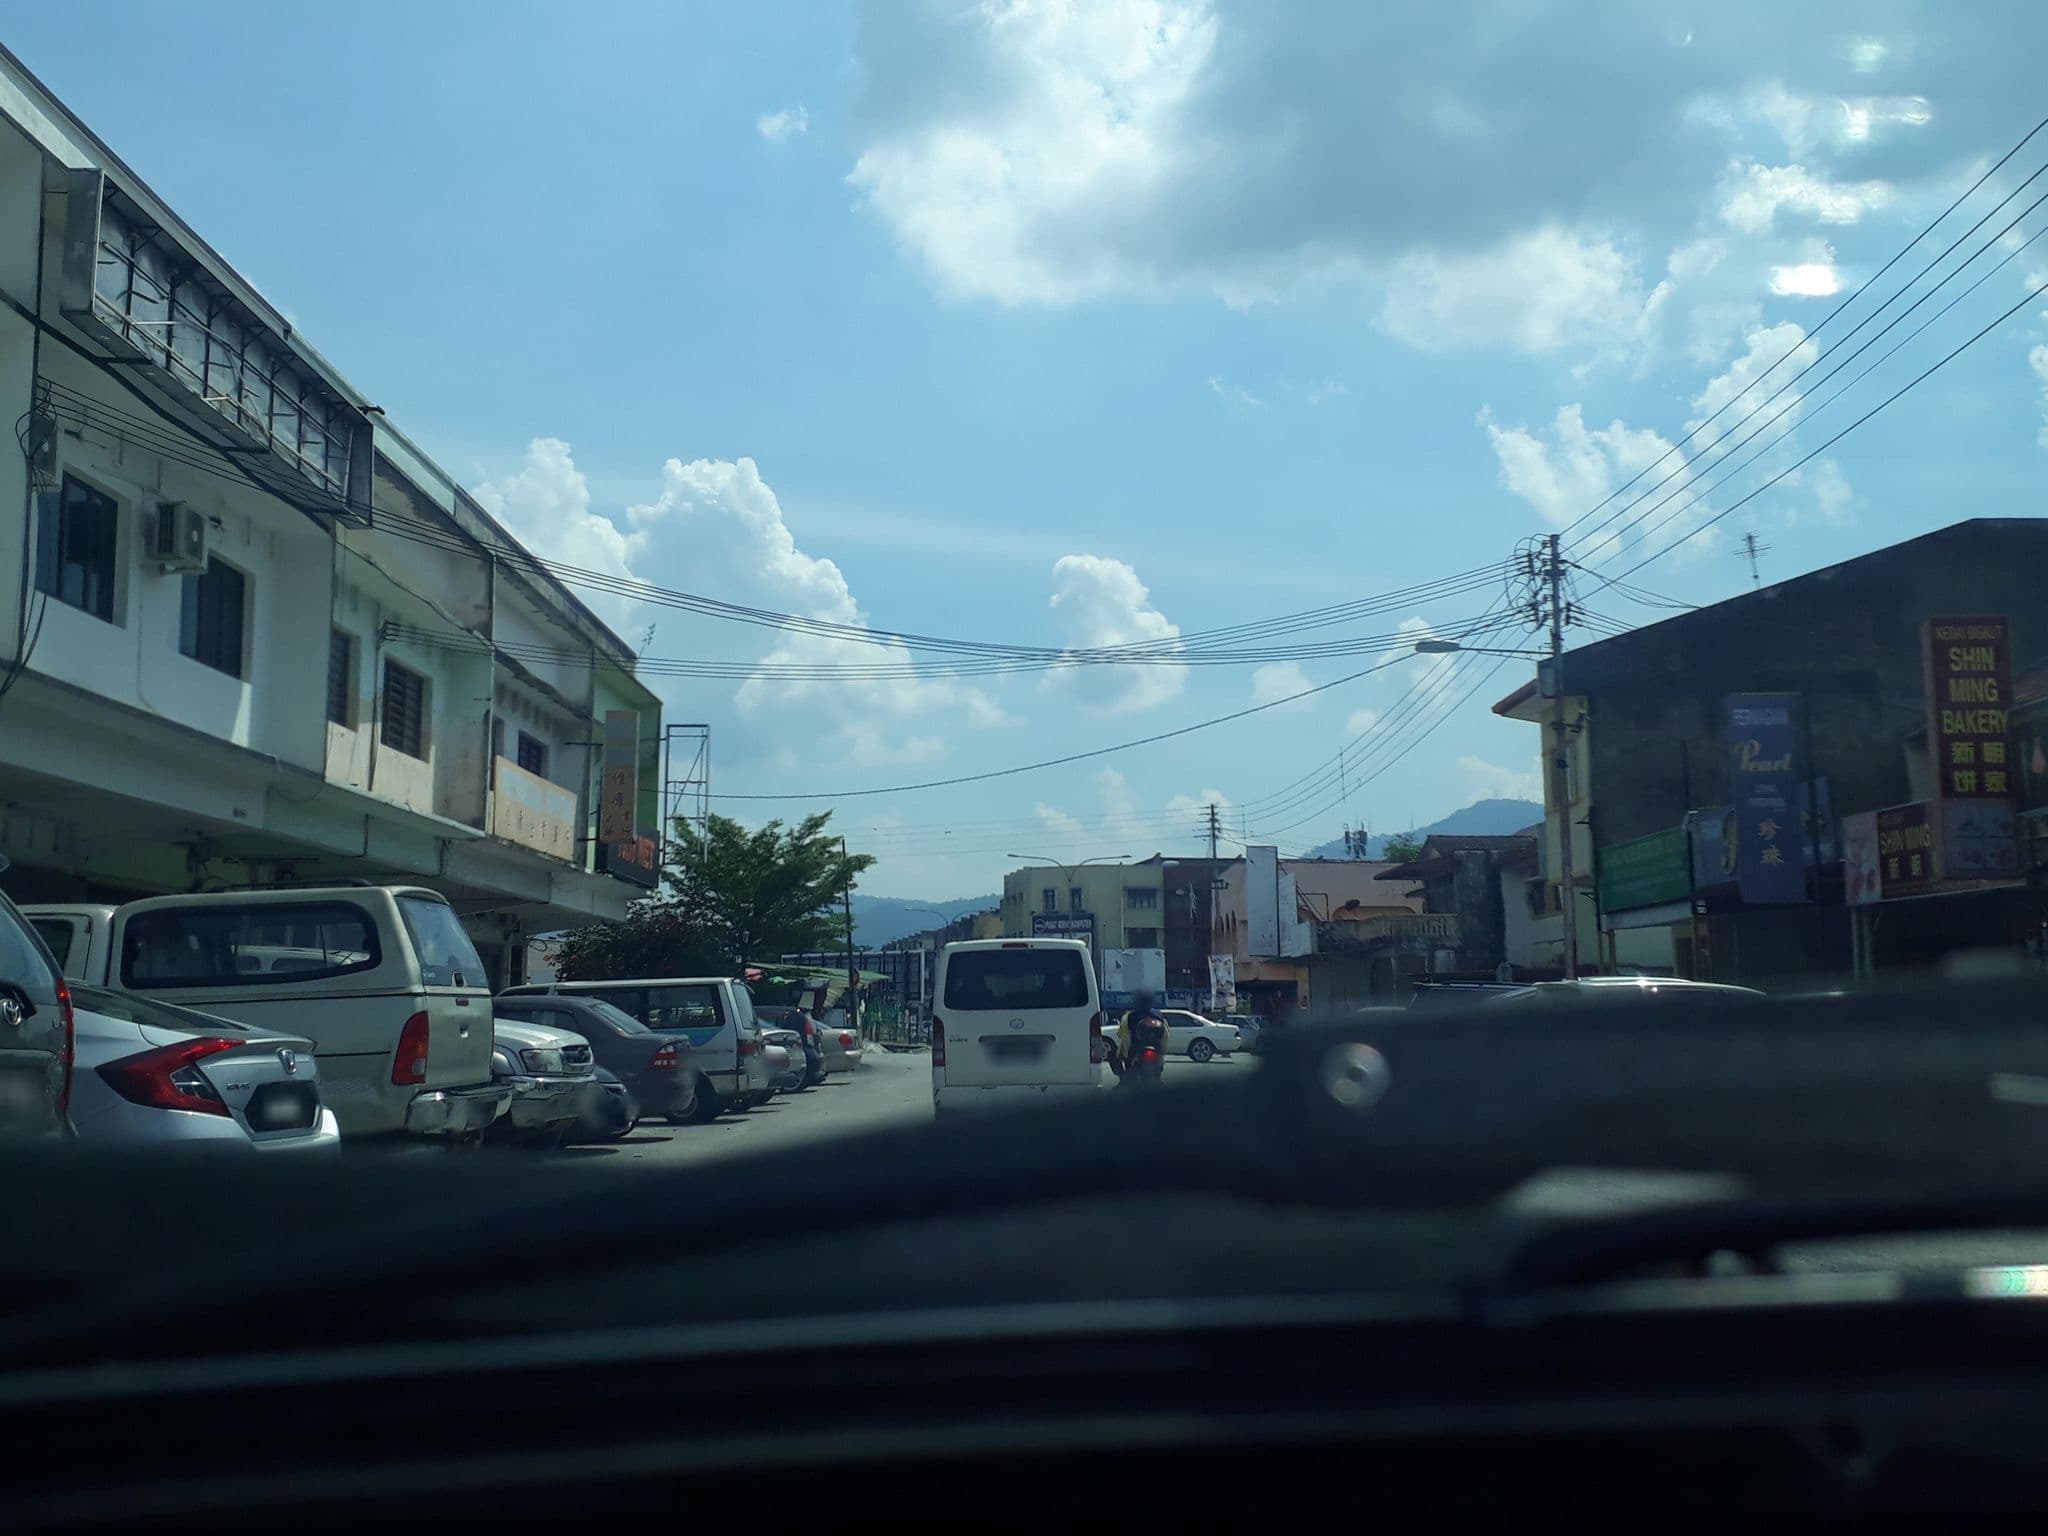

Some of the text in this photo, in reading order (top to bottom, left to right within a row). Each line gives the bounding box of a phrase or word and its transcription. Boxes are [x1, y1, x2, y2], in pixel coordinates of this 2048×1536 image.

[1949, 647, 1995, 672] SHIN
[1948, 677, 1999, 703] MING
[1942, 709, 2009, 735] BAKERY
